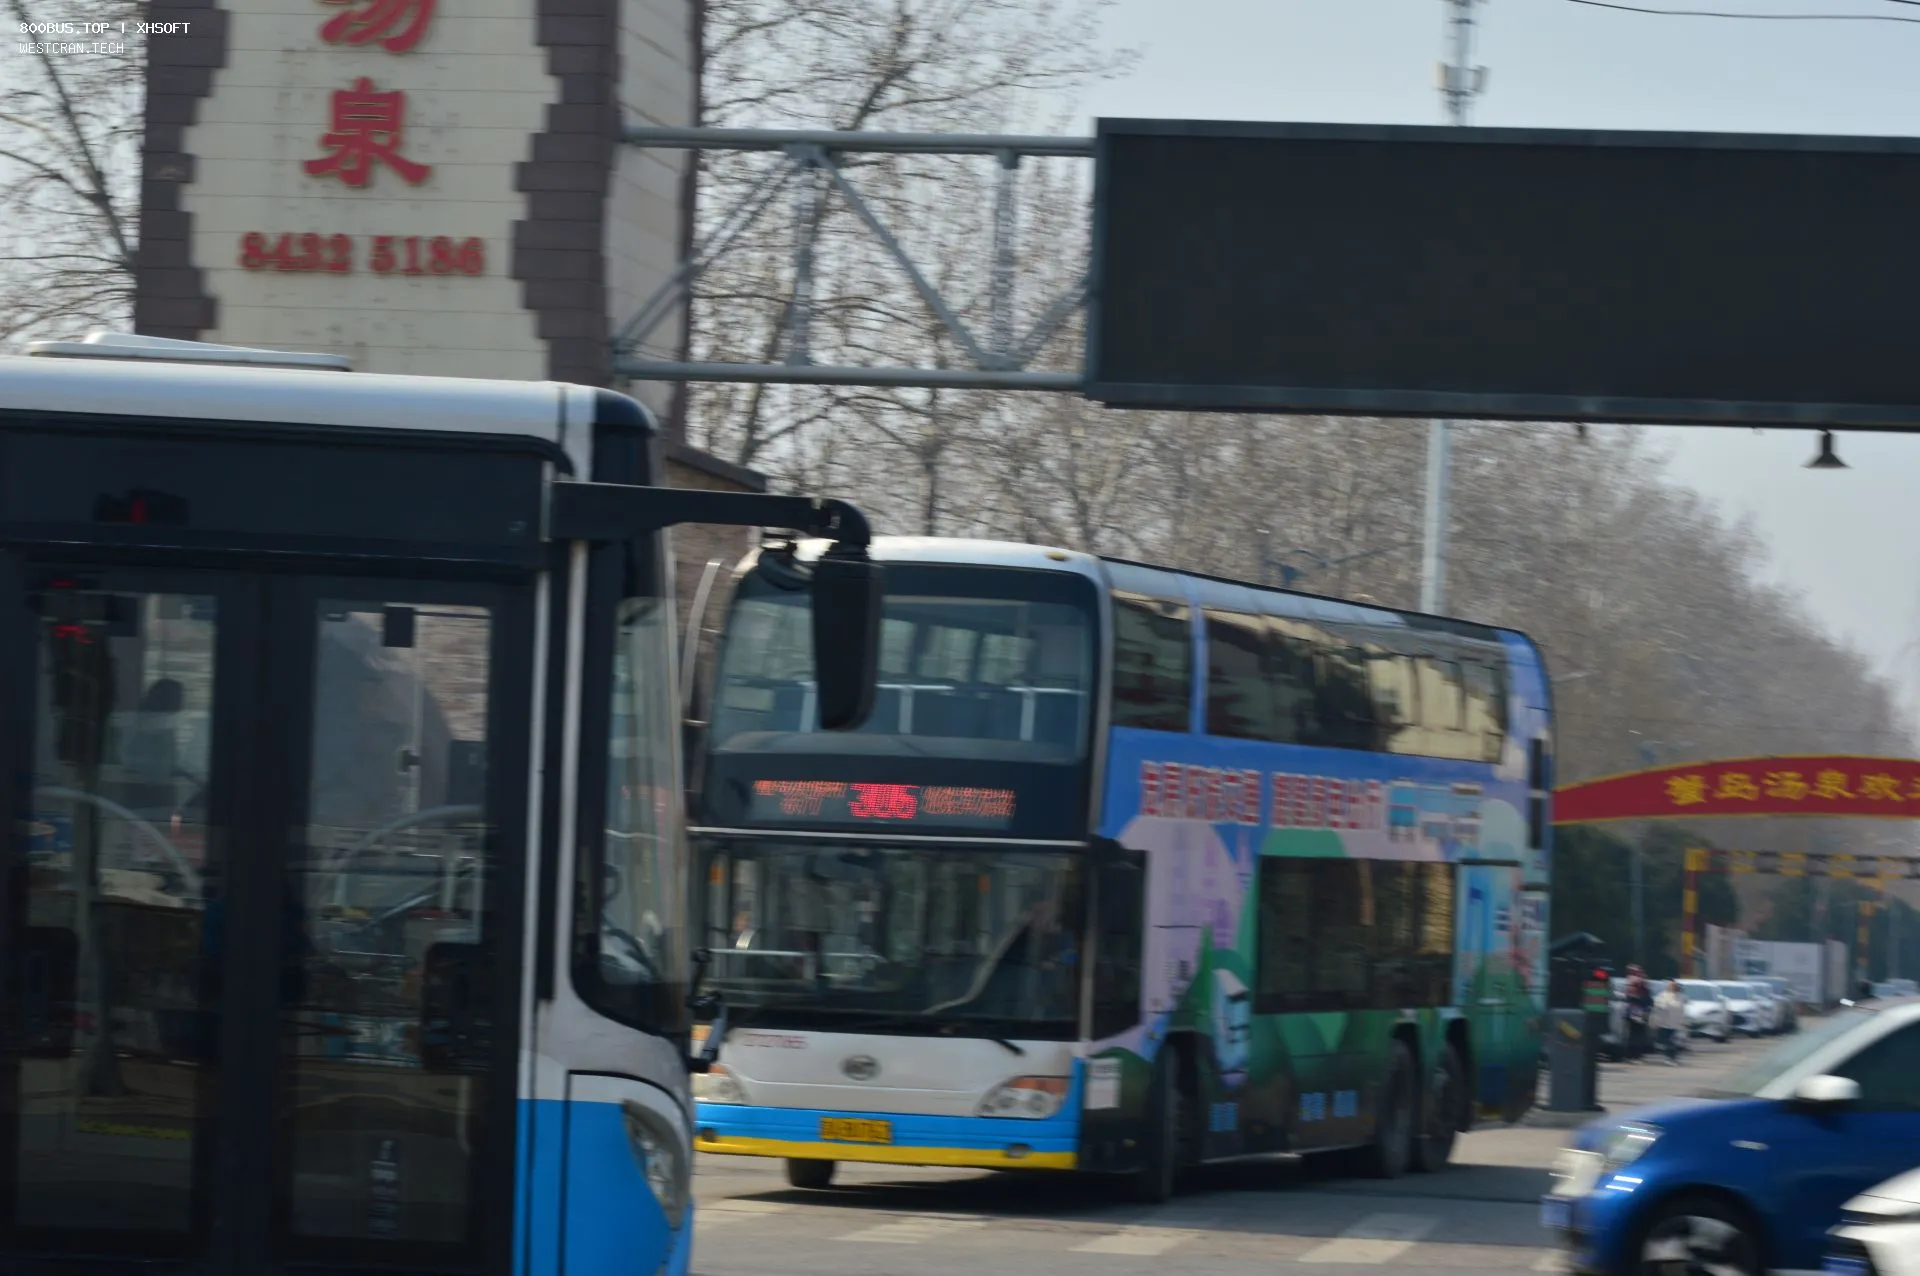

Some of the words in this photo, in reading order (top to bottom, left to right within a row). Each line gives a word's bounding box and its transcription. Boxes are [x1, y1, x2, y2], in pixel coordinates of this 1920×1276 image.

[1664, 768, 1920, 806] 蟹岛汤泉欢
